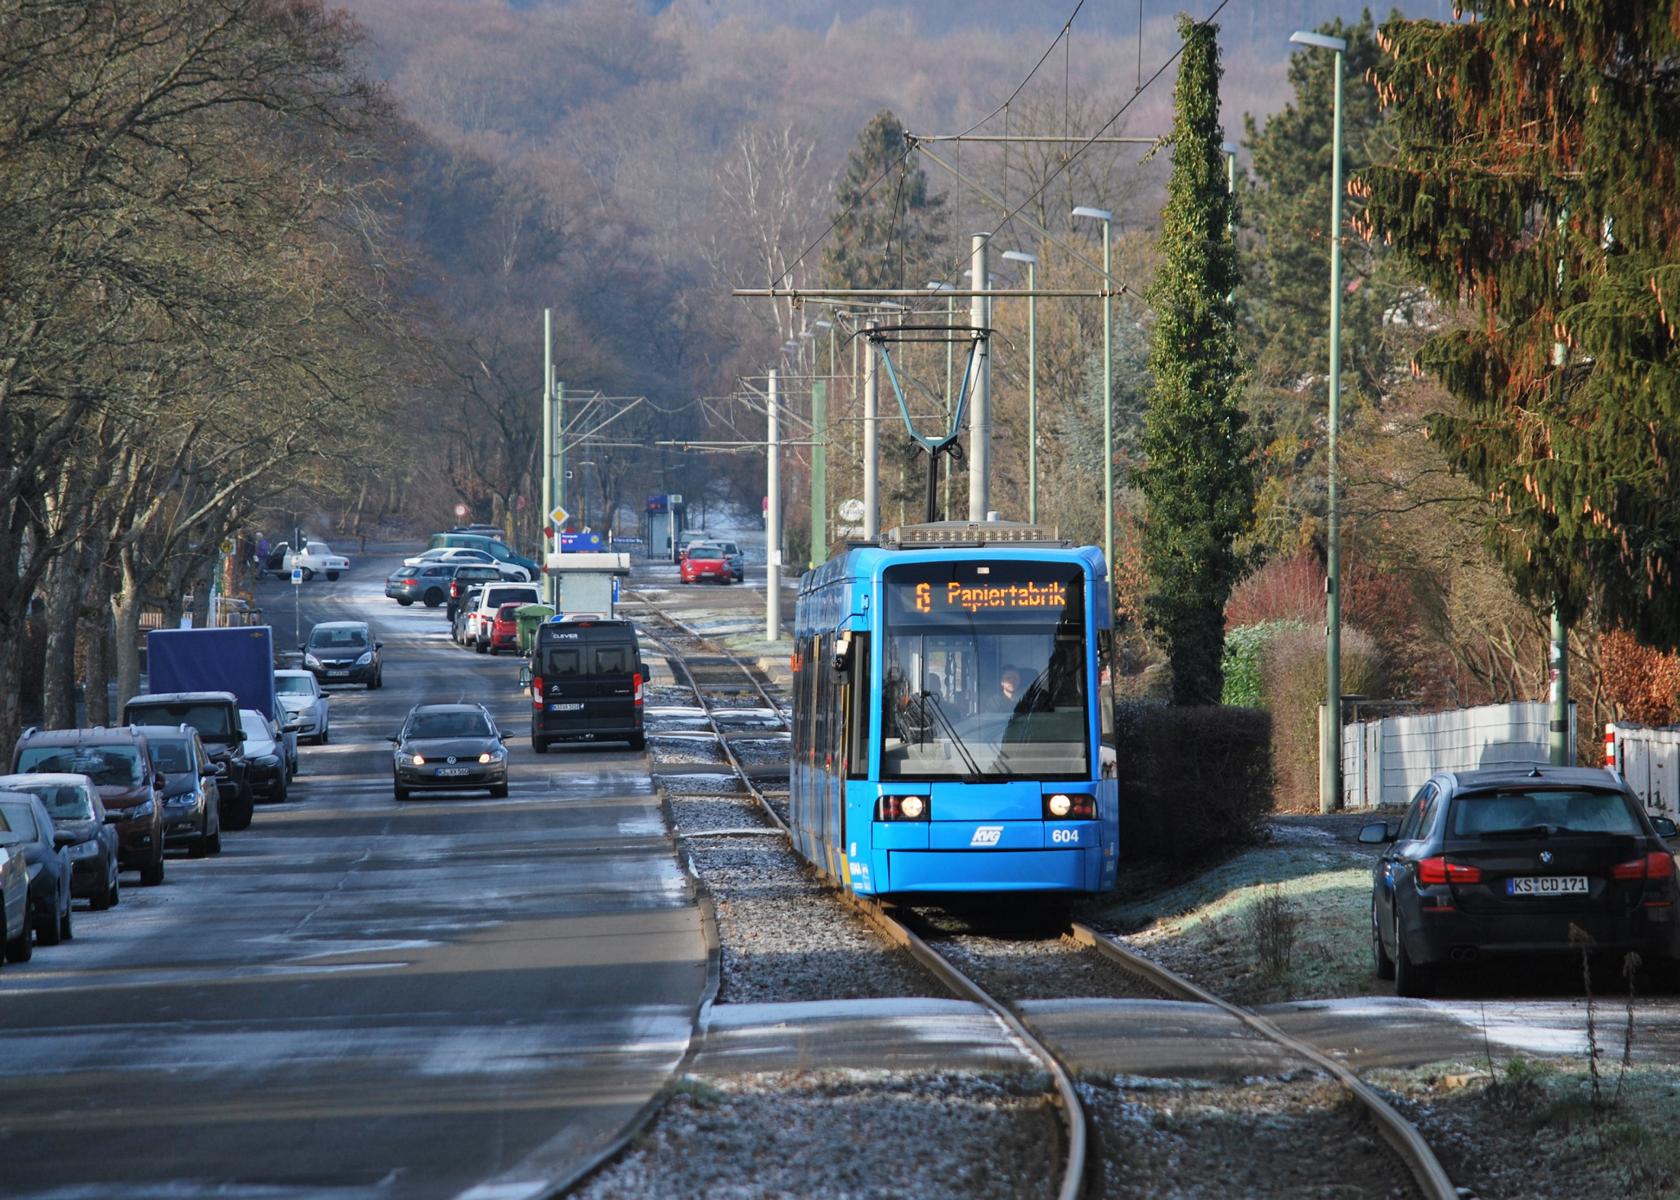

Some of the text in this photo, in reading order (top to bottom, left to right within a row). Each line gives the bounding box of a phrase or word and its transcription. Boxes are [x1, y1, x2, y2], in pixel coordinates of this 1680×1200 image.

[971, 828, 1003, 844] KVG
[1052, 829, 1079, 842] 604
[1514, 879, 1532, 892] KS
